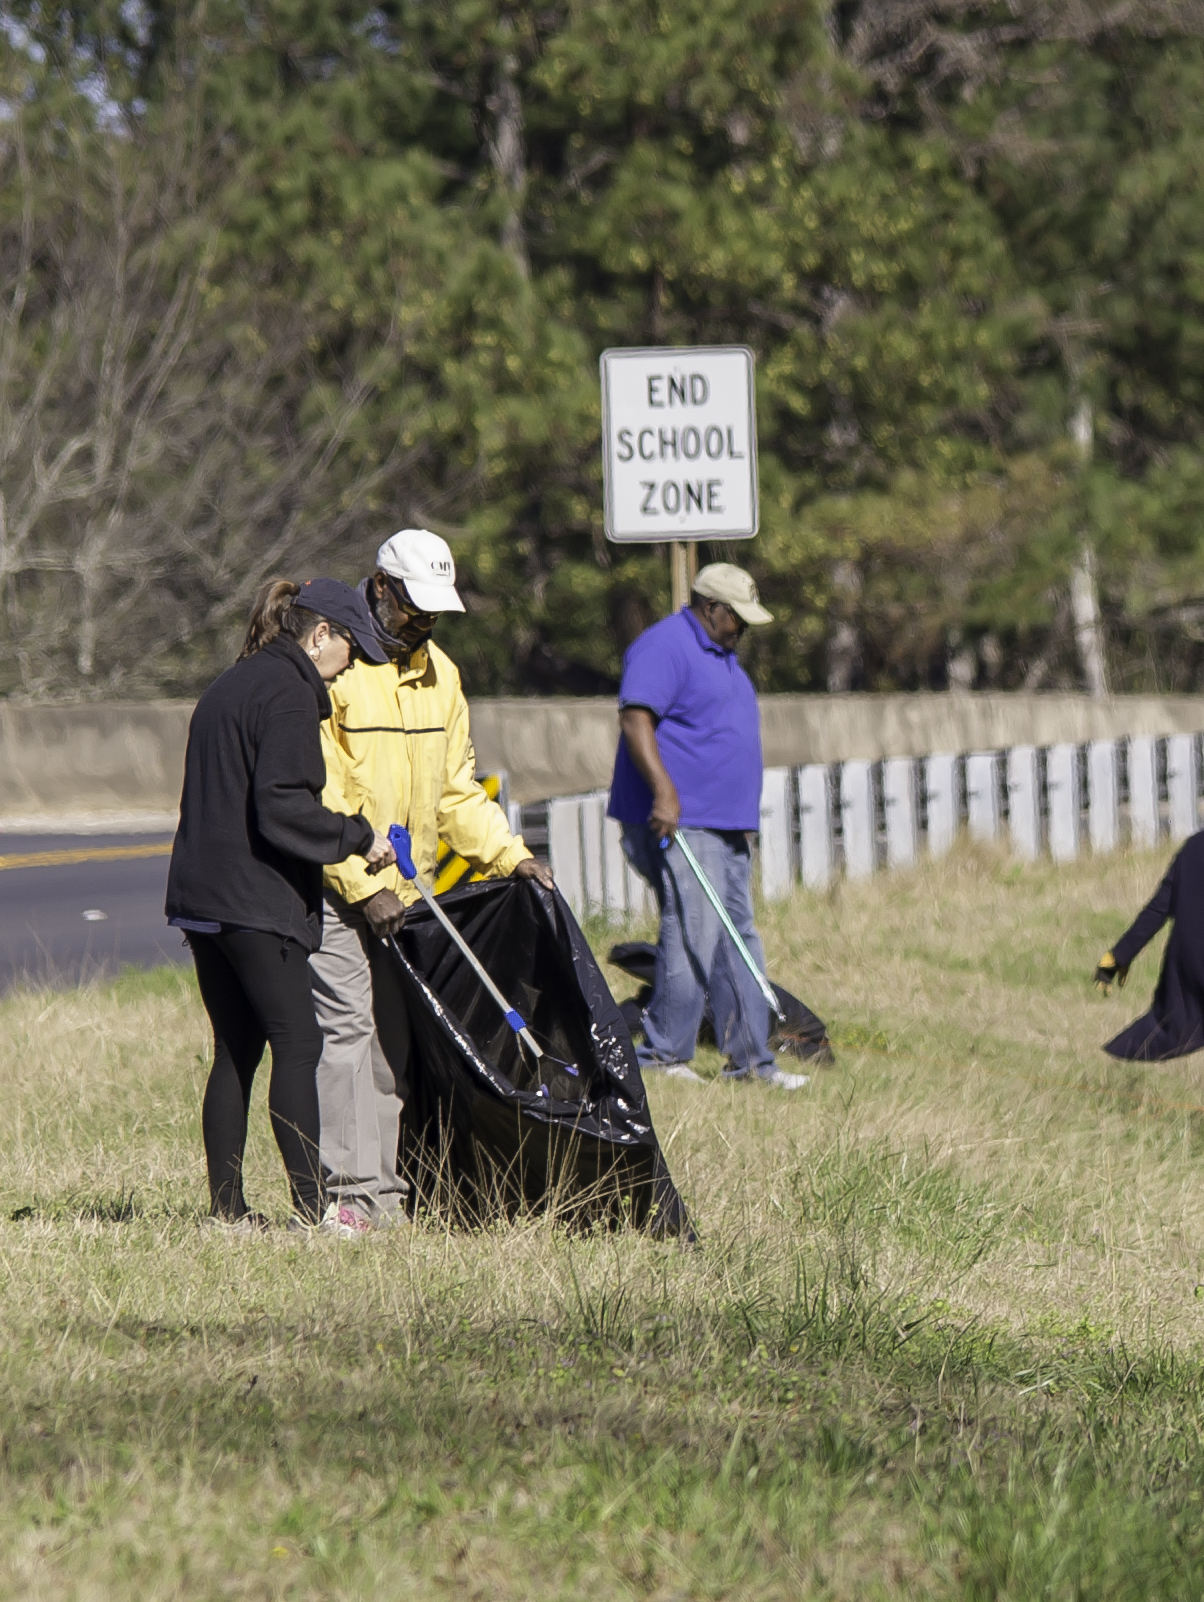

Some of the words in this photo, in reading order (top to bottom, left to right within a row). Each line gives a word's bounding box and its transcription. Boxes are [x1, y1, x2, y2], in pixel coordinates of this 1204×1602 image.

[646, 373, 710, 408] END
[616, 425, 744, 462] SCHOOL
[639, 479, 725, 515] ZONE
